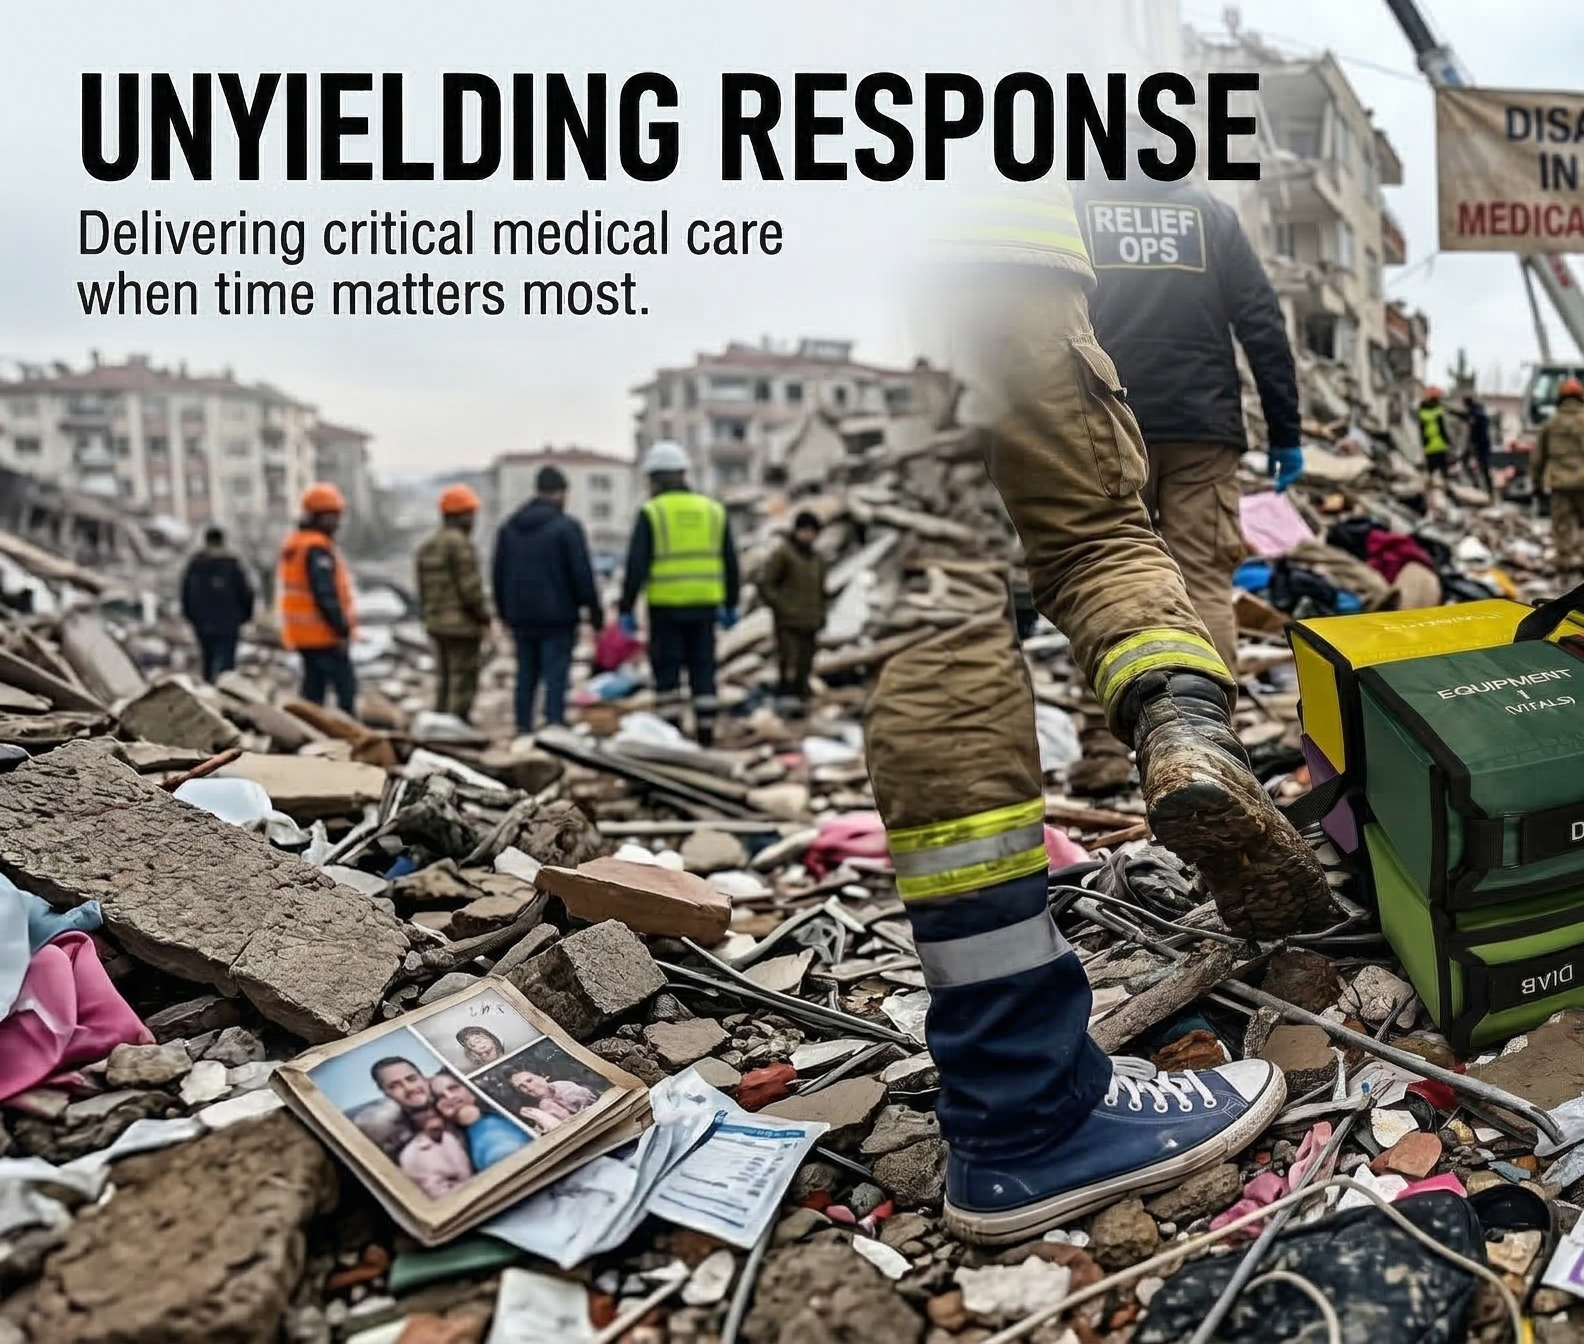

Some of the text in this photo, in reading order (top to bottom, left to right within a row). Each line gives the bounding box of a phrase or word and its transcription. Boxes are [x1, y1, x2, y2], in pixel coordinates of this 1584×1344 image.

[1539, 153, 1578, 191] IN
[1094, 206, 1194, 236] RELIEF
[1119, 236, 1179, 264] OPS
[1437, 669, 1572, 699] EQUIPMENT
[1505, 696, 1576, 715] (VITALS)
